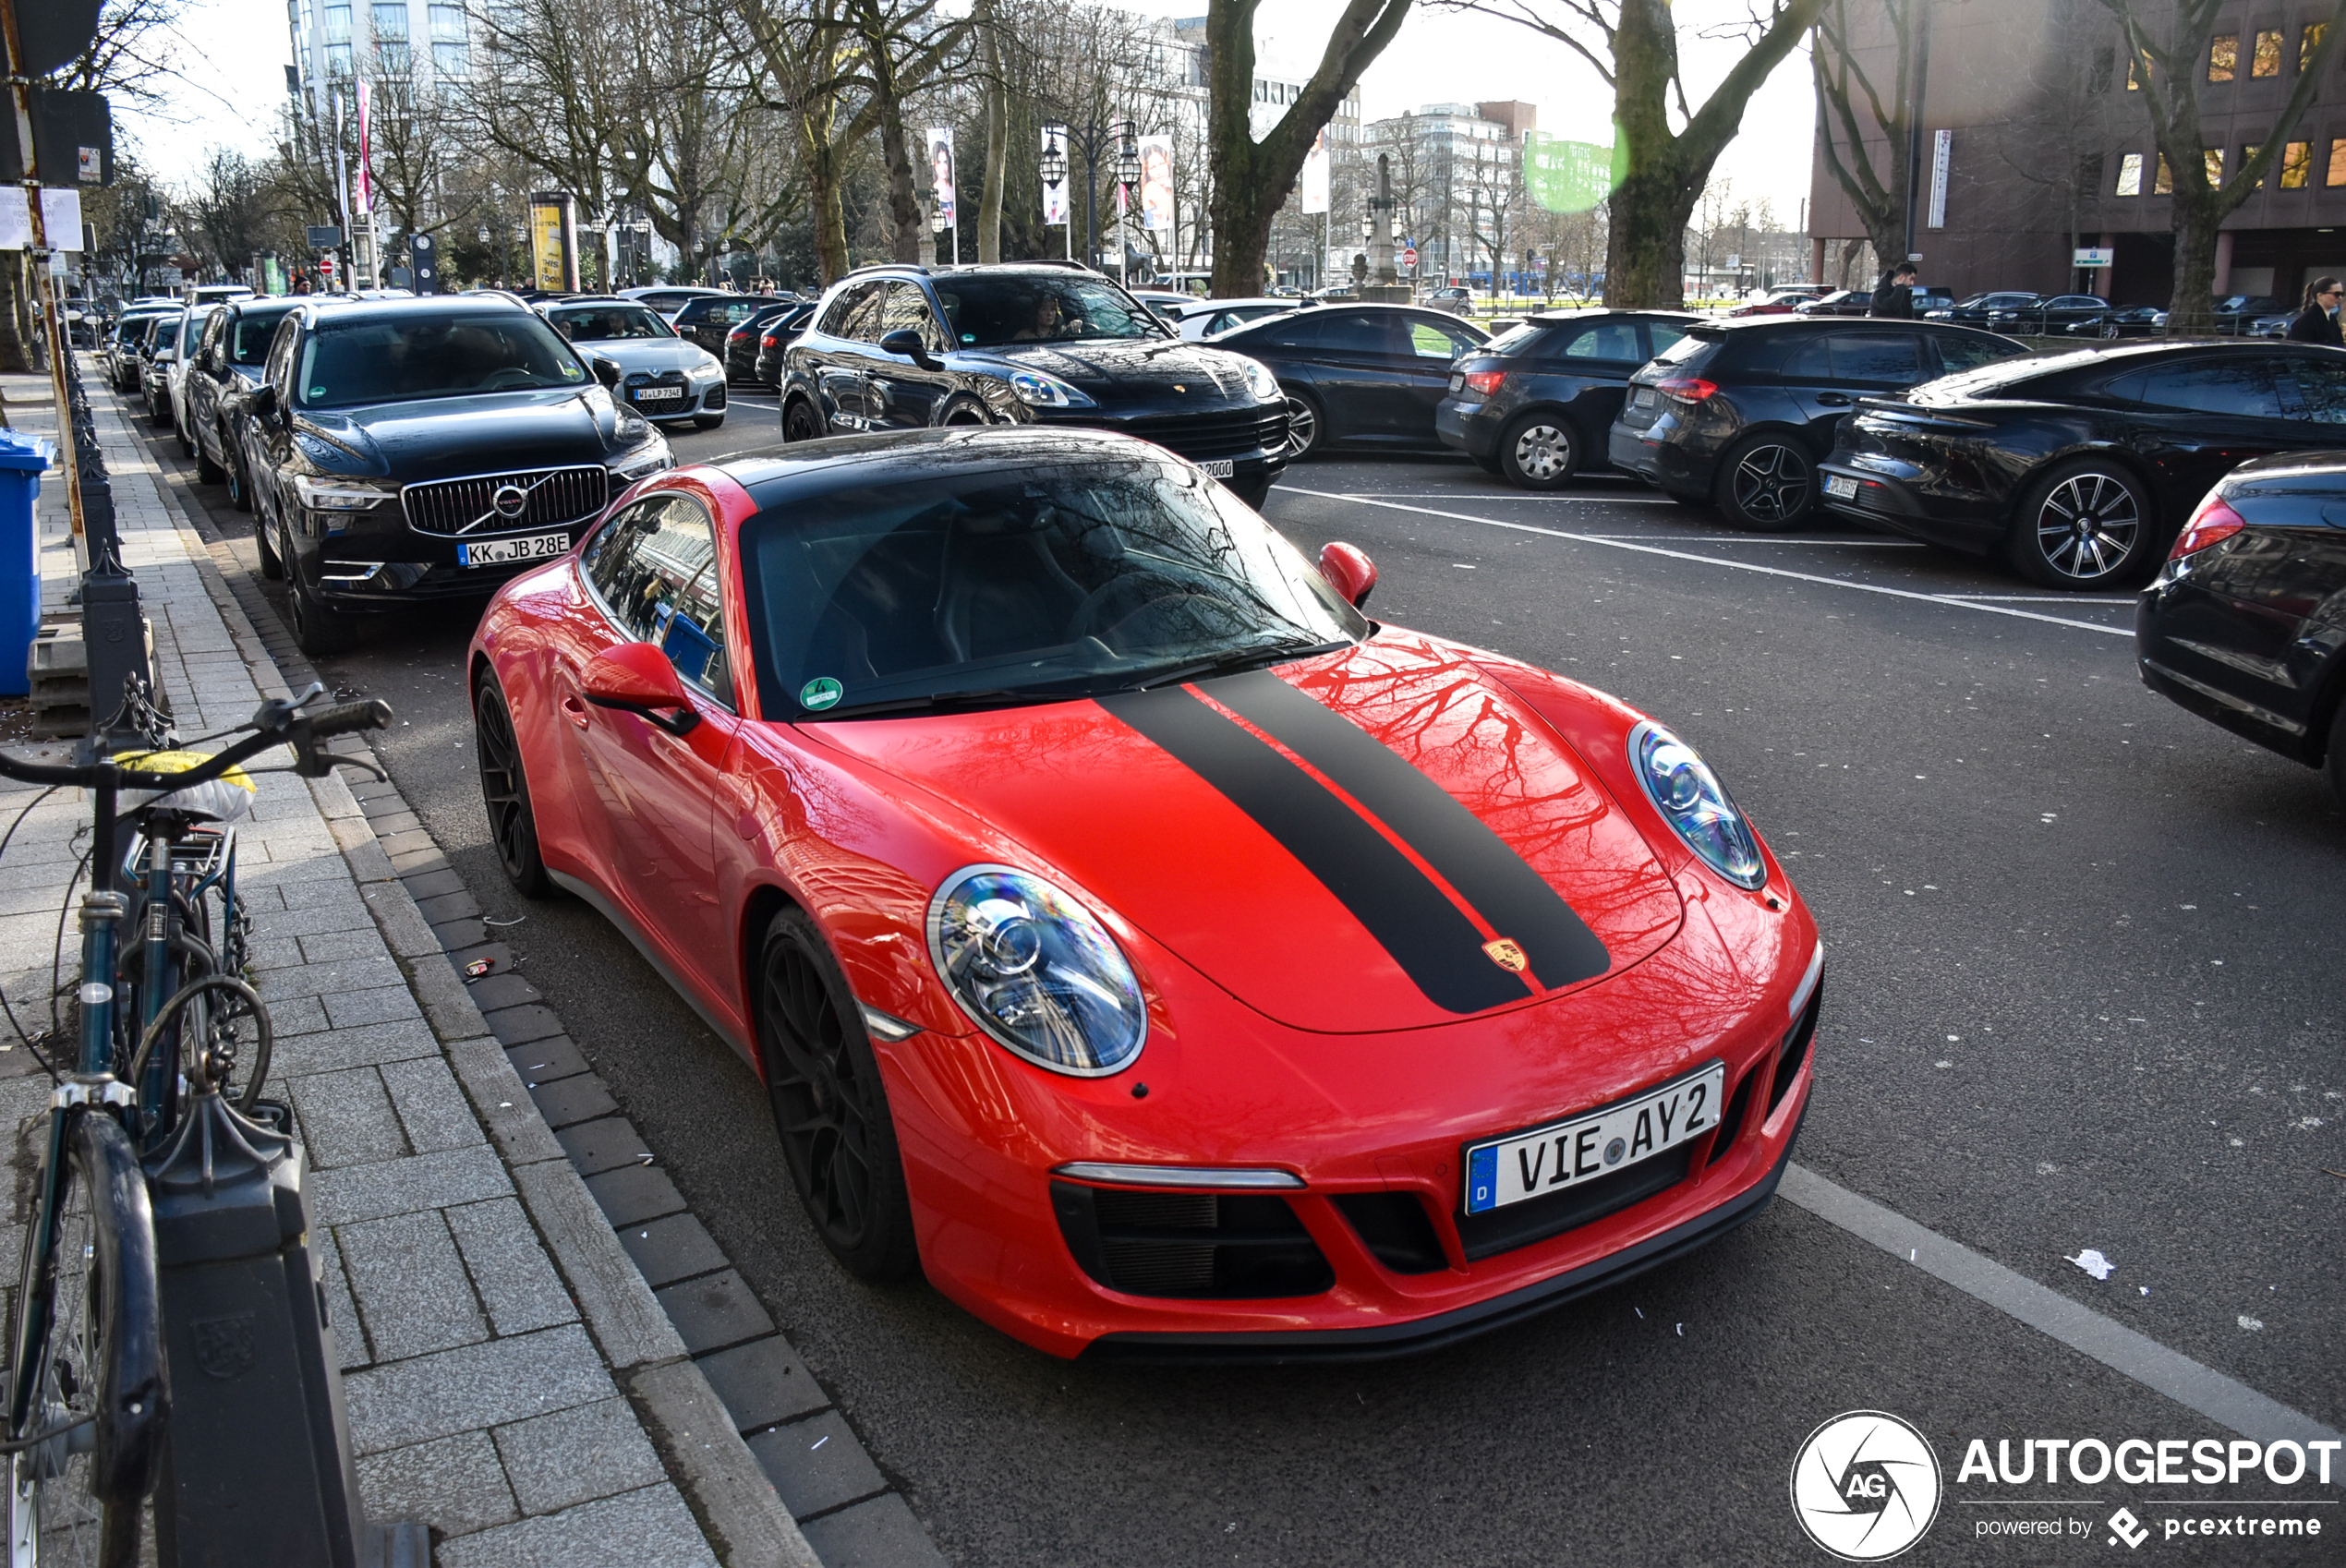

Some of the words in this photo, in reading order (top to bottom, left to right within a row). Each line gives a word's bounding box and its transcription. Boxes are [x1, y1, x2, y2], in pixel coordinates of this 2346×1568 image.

[542, 259, 559, 269] THIS
[1404, 254, 1417, 263] STOP
[541, 274, 561, 284] FOOD
[468, 544, 495, 563] KK
[507, 540, 531, 559] JB
[535, 536, 569, 555] 28E
[815, 679, 827, 694] 4
[1477, 1186, 1488, 1201] D
[1518, 1125, 1602, 1192] VIE
[1629, 1093, 1680, 1158] AY
